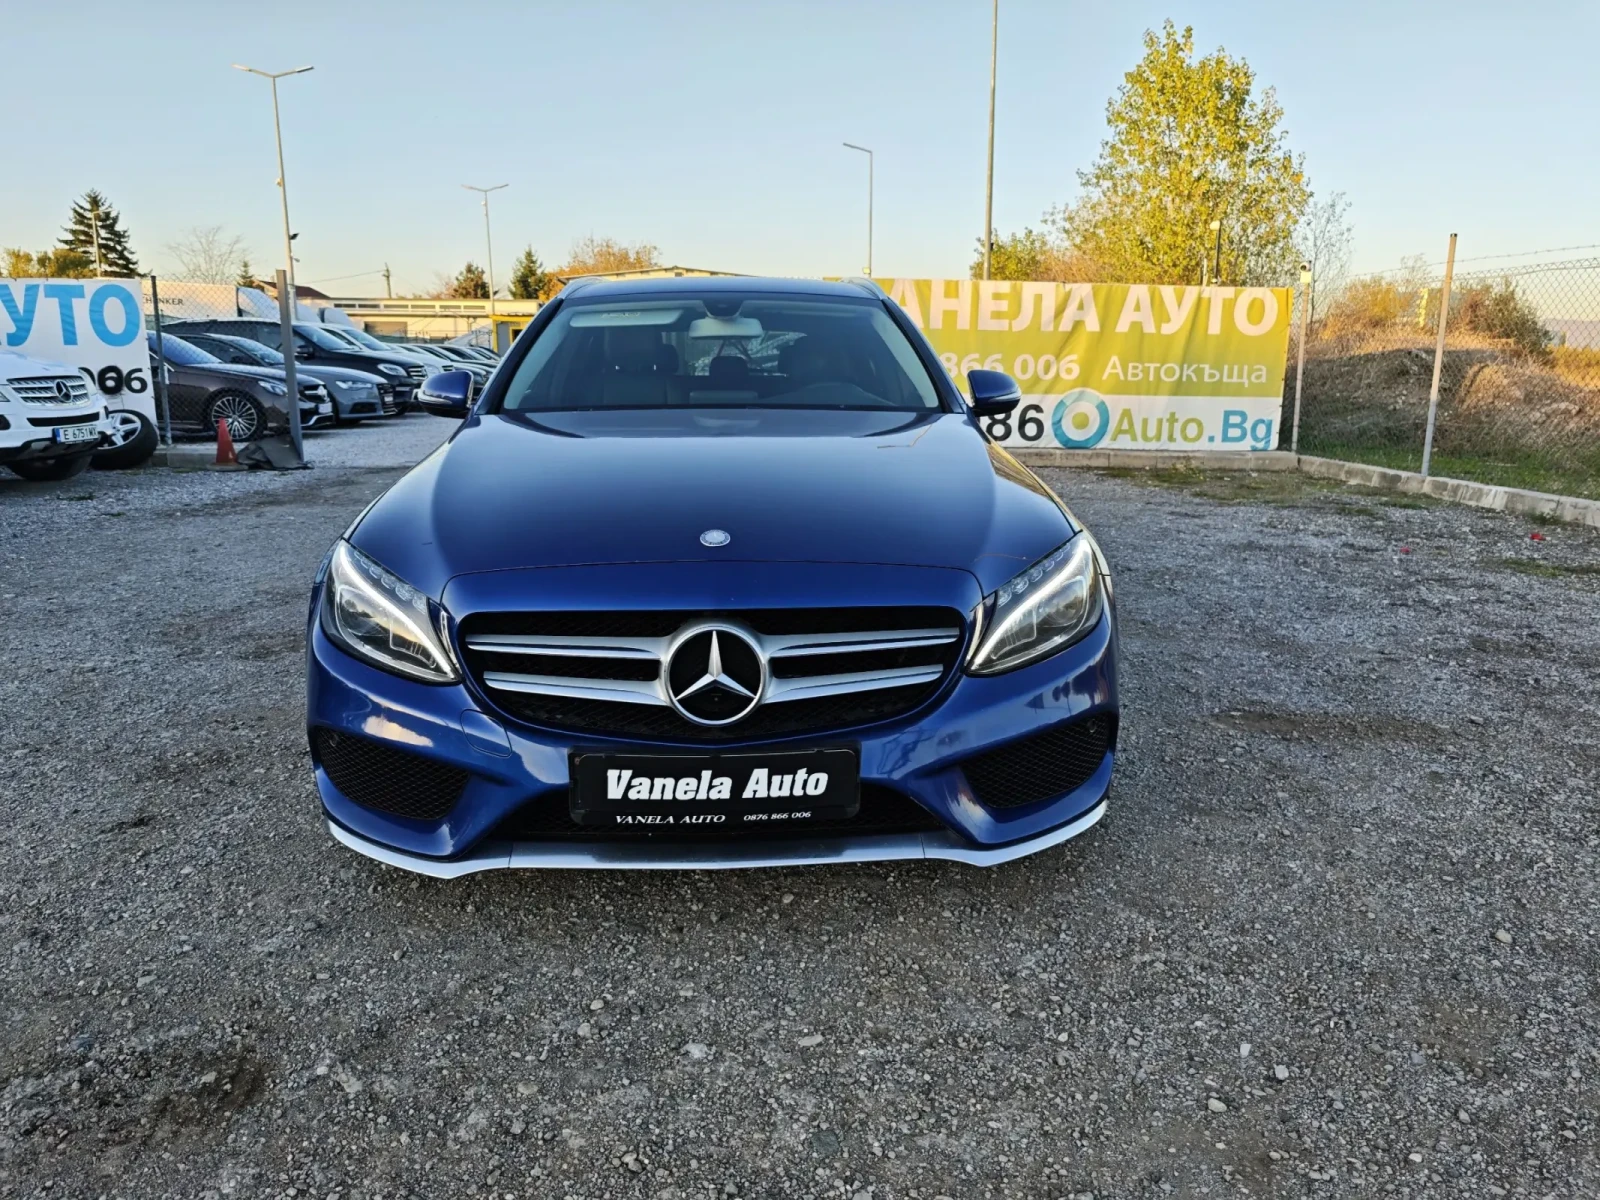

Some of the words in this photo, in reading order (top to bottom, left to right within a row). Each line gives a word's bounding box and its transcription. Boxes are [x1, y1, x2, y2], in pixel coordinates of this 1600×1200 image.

[0, 284, 140, 347] УТО
[1115, 285, 1279, 336] АУТО
[1014, 354, 1080, 380] 006
[1102, 355, 1267, 387] Автокъща
[63, 429, 70, 440] E
[1110, 408, 1273, 450] Auto.Bg
[606, 769, 733, 800] Vanela
[742, 768, 829, 799] Auto
[615, 815, 675, 824] VANELA
[680, 814, 726, 824] AUTO
[743, 813, 769, 822] 0876
[770, 812, 789, 820] 866
[791, 811, 812, 819] 006
